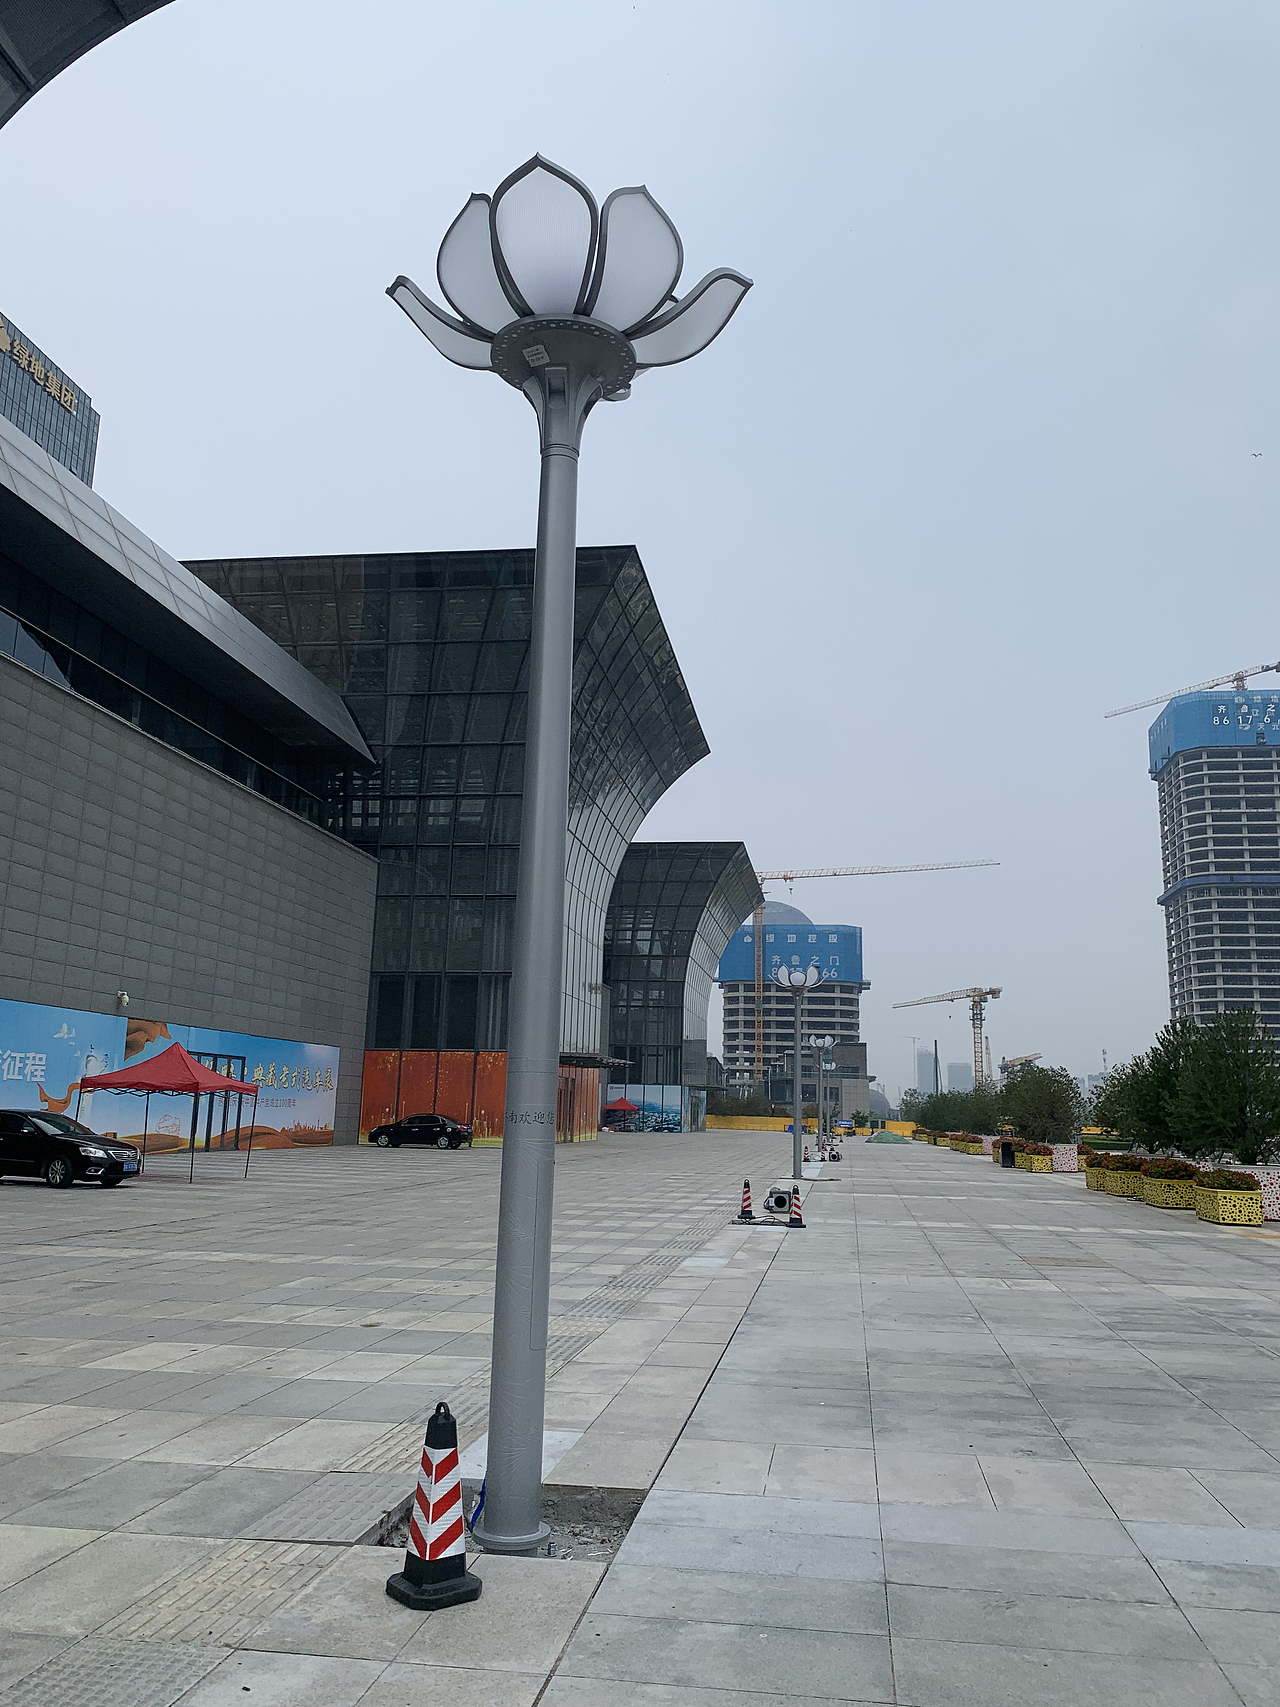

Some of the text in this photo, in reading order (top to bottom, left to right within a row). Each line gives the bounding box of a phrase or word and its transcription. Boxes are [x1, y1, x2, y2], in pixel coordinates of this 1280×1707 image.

[12, 339, 76, 413] 绿地集团
[772, 955, 840, 965] 齐鲁之门
[0, 1049, 47, 1082] 征程
